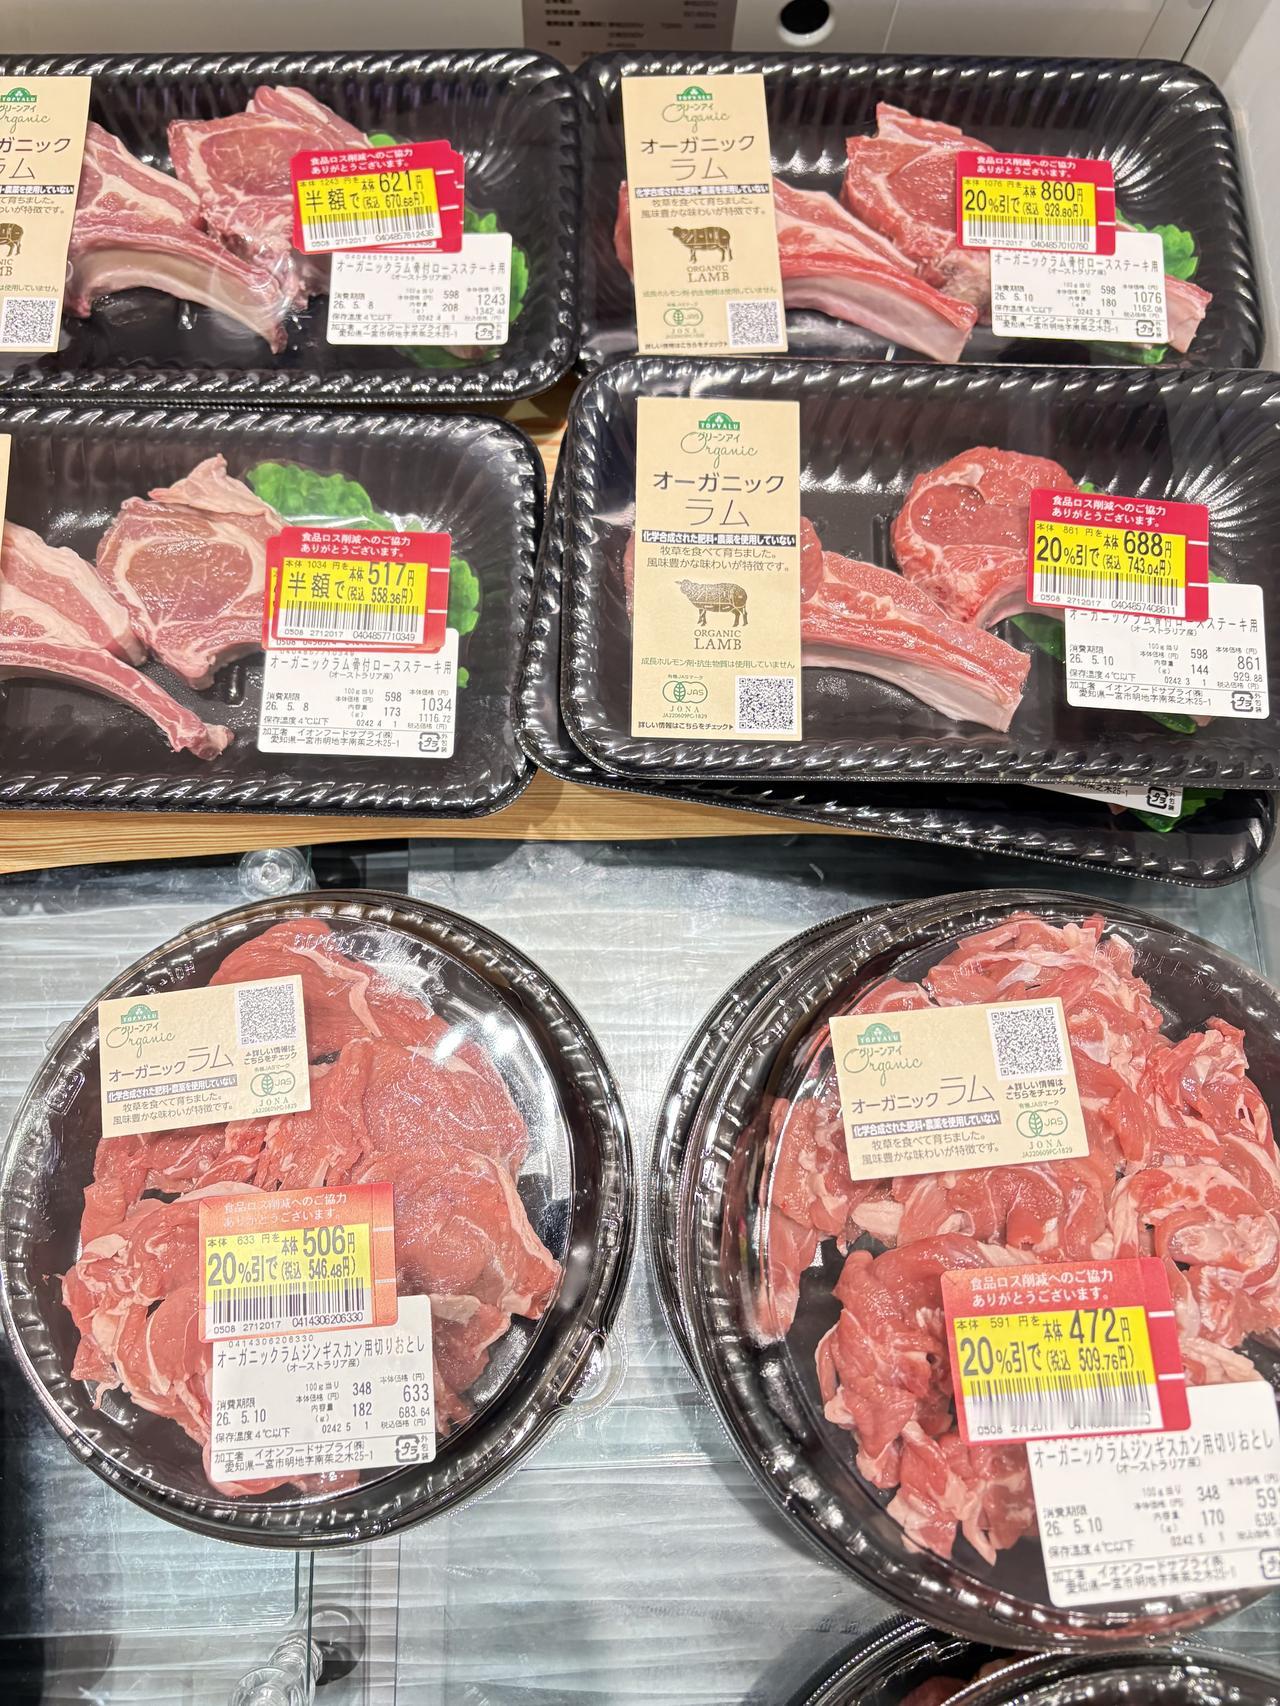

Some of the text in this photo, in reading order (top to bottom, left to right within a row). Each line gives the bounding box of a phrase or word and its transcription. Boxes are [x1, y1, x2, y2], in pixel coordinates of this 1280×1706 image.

[677, 103, 714, 111] グリーンアイ
[662, 104, 730, 133] Organic
[641, 136, 755, 155] オーガニック
[670, 157, 728, 181] ラム
[976, 156, 1076, 169] 食品ロス削減へのご協力
[977, 165, 1071, 178] ありがとうございます。
[305, 188, 360, 213] 半額で
[688, 272, 729, 283] LAMB
[477, 294, 506, 306] 1243
[1134, 292, 1162, 304] 1076
[697, 432, 741, 443] グリーンアイ
[681, 432, 758, 469] Organic
[653, 471, 784, 493] オーガニック
[685, 499, 749, 526] ラム
[1052, 495, 1166, 516] 食品ロス削減へのご協力
[1051, 508, 1160, 528] ありがとうございます。
[1036, 523, 1054, 532] 本体
[1063, 527, 1079, 535] 861
[302, 532, 411, 546] 食品ロス削減へのご協力
[643, 531, 795, 545] 化学合成された肥料・農薬を使用していない
[1103, 534, 1119, 550] 本体
[301, 543, 404, 557] ありがとうございます。
[660, 546, 776, 559] 牧草を食べて育ちました。
[1036, 535, 1099, 567] 20%引で
[285, 560, 302, 568] 本体
[307, 560, 327, 568] 1034
[647, 557, 789, 572] 風味豊かな味わいが特徴です。
[348, 567, 364, 581] 本体
[288, 572, 345, 599] 半額で
[371, 587, 413, 605] 558.36円)
[353, 631, 415, 641] 0404857710349
[694, 630, 742, 638] ORGANIC
[694, 638, 742, 650] LAMB
[1190, 649, 1208, 659] 598
[270, 656, 452, 675] オーガニックラム骨付ロースステーキ用
[1191, 664, 1209, 675] 144
[1237, 656, 1260, 671] 861
[385, 692, 402, 702] 598
[422, 697, 452, 712] 1034
[384, 707, 401, 717] 173
[121, 1022, 159, 1035] グリーンアイ
[106, 1026, 175, 1058] Organic
[244, 1052, 297, 1065] こちらをチェック
[859, 1045, 902, 1058] グリーンアイ
[109, 1045, 234, 1083] オーガニック ラム
[843, 1049, 923, 1086] Organic
[275, 1078, 292, 1086] JAS
[852, 1074, 995, 1114] オーガニック ラム
[1006, 1087, 1066, 1100] こちらをチェック
[123, 1094, 222, 1112] 牧草を食べて育ちました。
[113, 1105, 233, 1125] 風味豊かな味わいが特徴です。
[1044, 1117, 1063, 1126] JAS
[871, 1132, 986, 1150] 牧草を食べて育ちました。
[862, 1143, 999, 1165] 風味豊かな味わいが特徴です。
[224, 1193, 347, 1214] 食品ロス削減へのご協力
[207, 1238, 227, 1248] 本体
[237, 1235, 255, 1245] 633
[281, 1236, 298, 1256] 本体
[208, 1252, 278, 1286] 20%引で
[308, 1256, 356, 1280] 546.48円)
[971, 1269, 1114, 1290] 食品ロス削減へのご協力
[972, 1287, 1109, 1308] ありがとうございます。
[213, 1312, 363, 1334] 0508 2712017 0414306206330
[956, 1319, 979, 1330] 本体
[990, 1317, 1011, 1328] 591
[1043, 1320, 1063, 1341] 本体
[217, 1335, 425, 1368] オーガニックラムジンギスカン用切りおとし
[960, 1337, 1042, 1376] 20%引で
[1078, 1345, 1134, 1371] 509.76円)
[286, 1359, 360, 1373] (オーストラリア産)
[352, 1382, 372, 1396] 348
[403, 1384, 429, 1402] 633
[216, 1397, 256, 1411] 消費期限
[353, 1403, 372, 1417] 182
[1034, 1430, 1273, 1468] オーガニックラムジンギスカン用切りおとし
[1197, 1485, 1221, 1502] 348
[1201, 1509, 1225, 1526] 170
